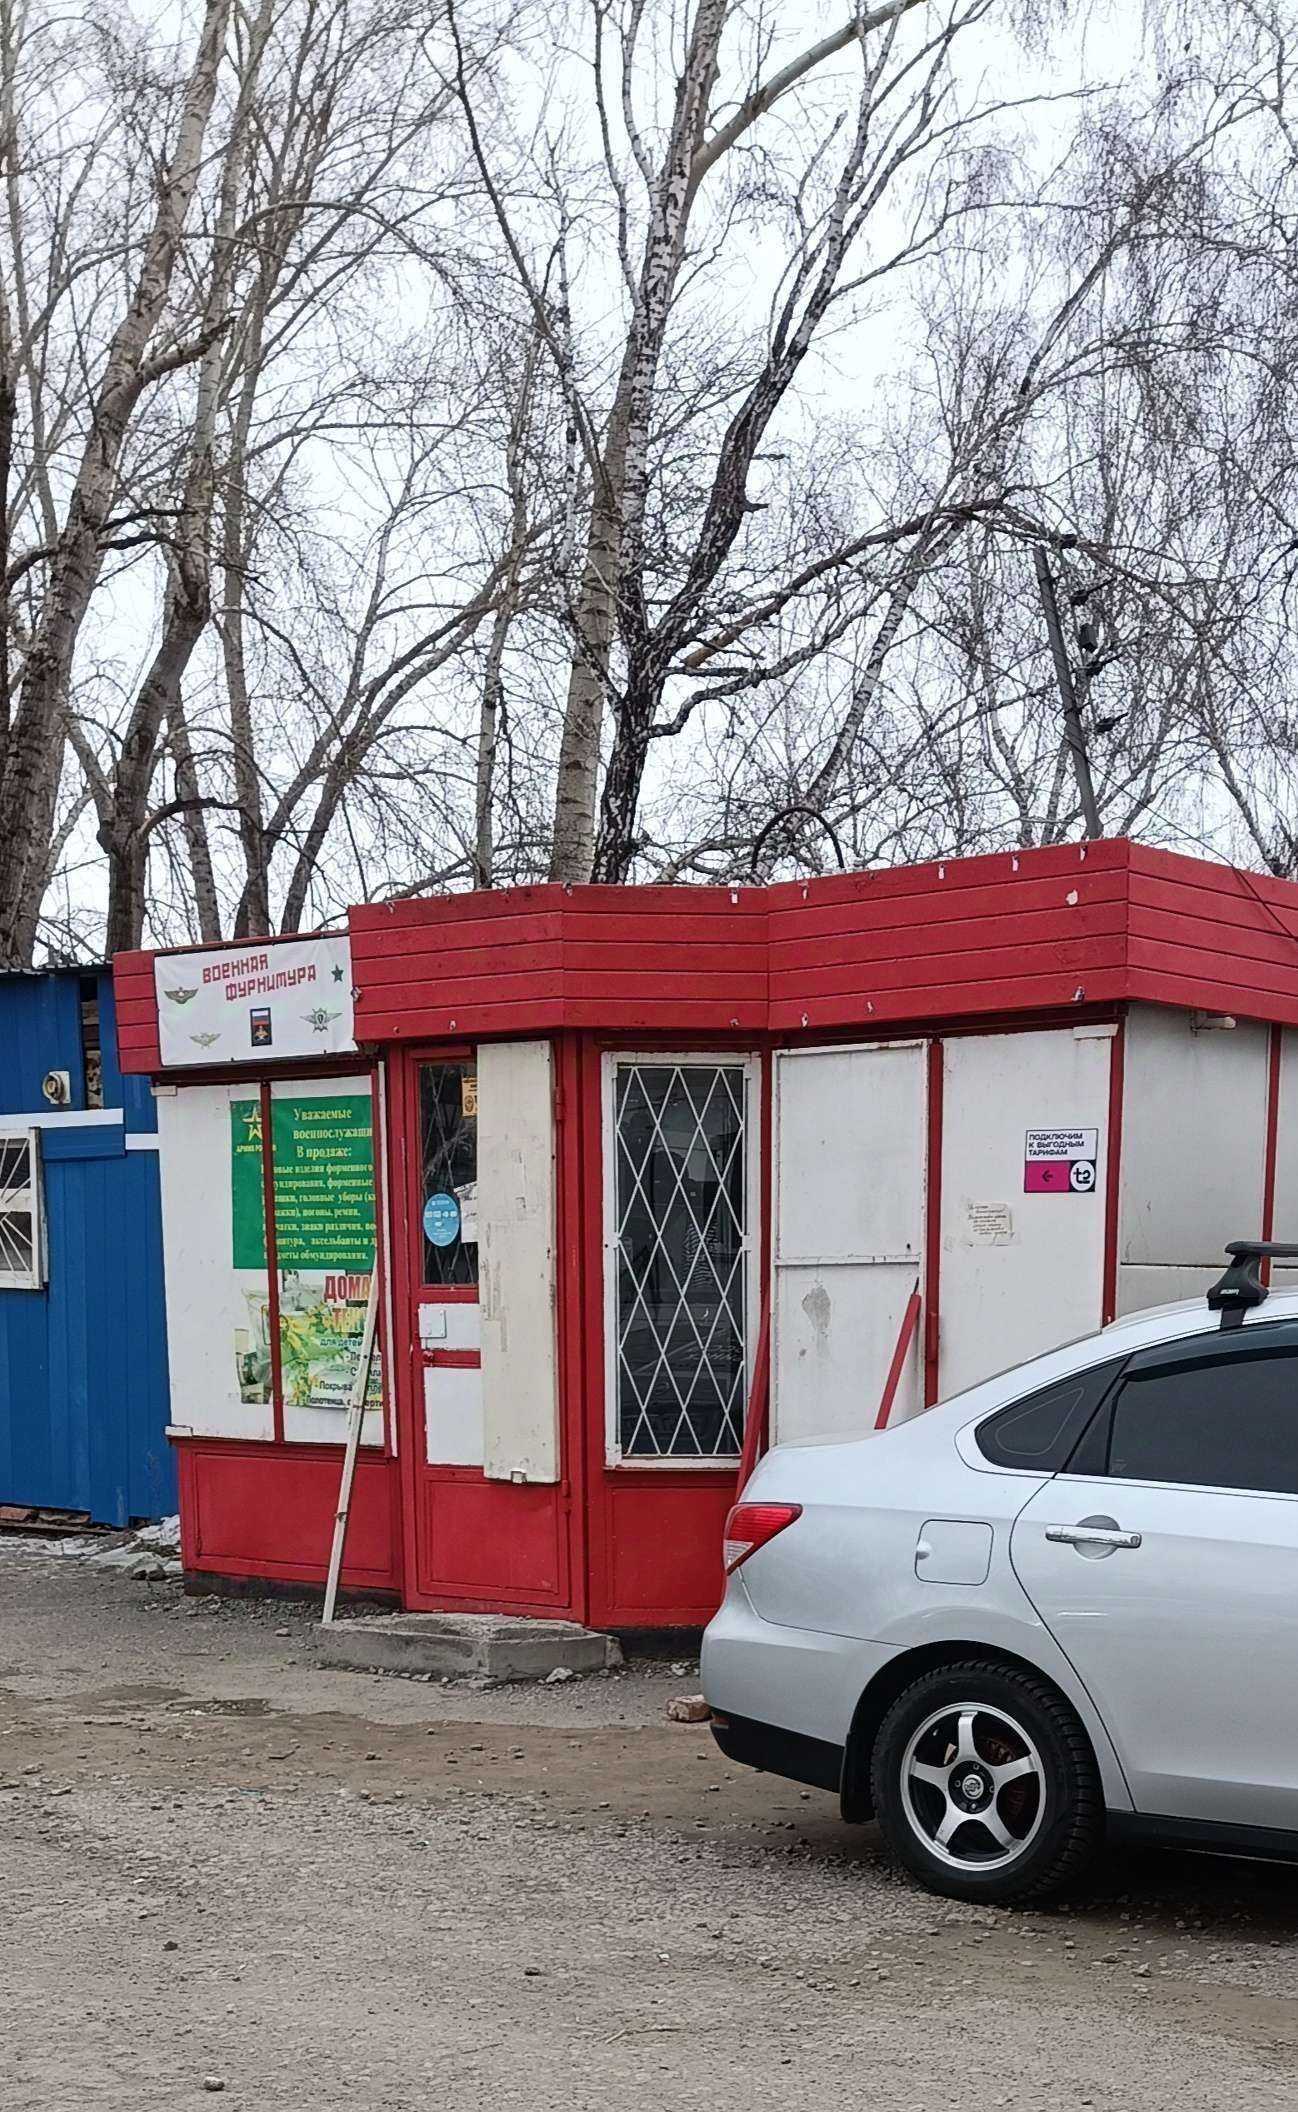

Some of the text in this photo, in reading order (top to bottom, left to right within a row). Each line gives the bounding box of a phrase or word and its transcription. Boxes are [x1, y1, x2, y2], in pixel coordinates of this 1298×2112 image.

[202, 953, 269, 984] ВОЕННАЯ
[225, 964, 317, 1001] ФУРНИТУРА
[293, 1108, 353, 1121] Уважаемые
[293, 1128, 373, 1141] военнослужащи
[1029, 1133, 1083, 1141] ПОДКЛЮЧИМ
[296, 1146, 304, 1158] В
[324, 1275, 371, 1303] ДОМА
